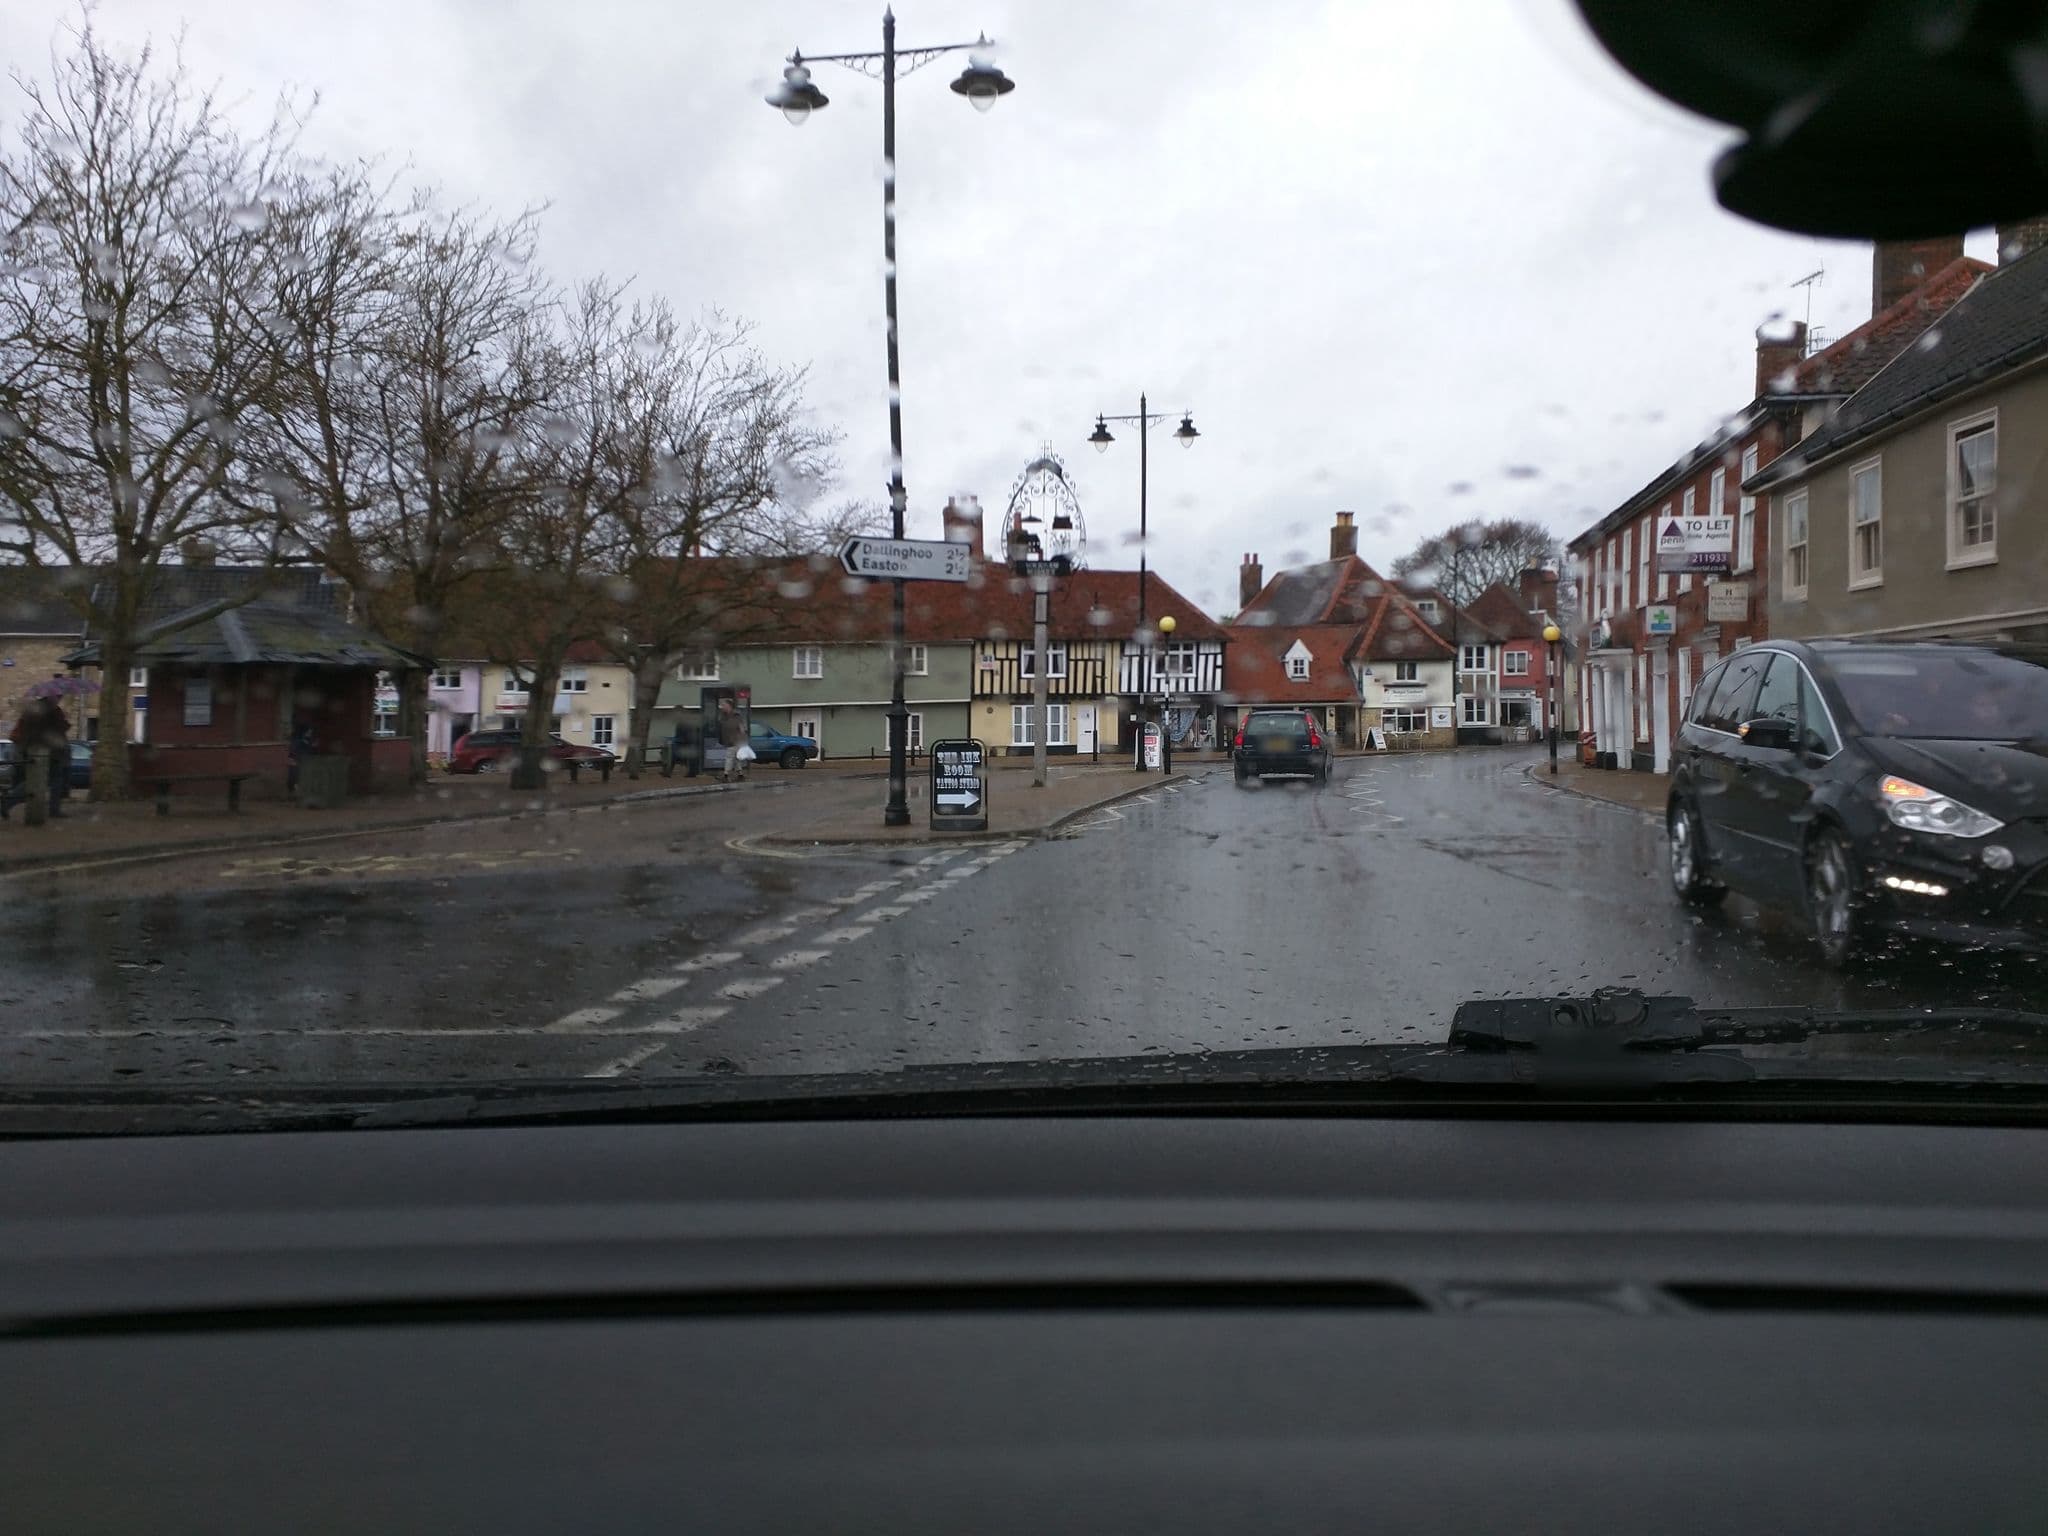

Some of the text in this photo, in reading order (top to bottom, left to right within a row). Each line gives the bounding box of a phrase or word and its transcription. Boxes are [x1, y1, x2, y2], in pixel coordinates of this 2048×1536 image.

[1685, 519, 1731, 531] TO LET
[862, 558, 907, 572] Easton
[961, 752, 980, 762] INK
[944, 765, 973, 776] ROOM
[936, 778, 979, 789] TATTOO STUDIO
